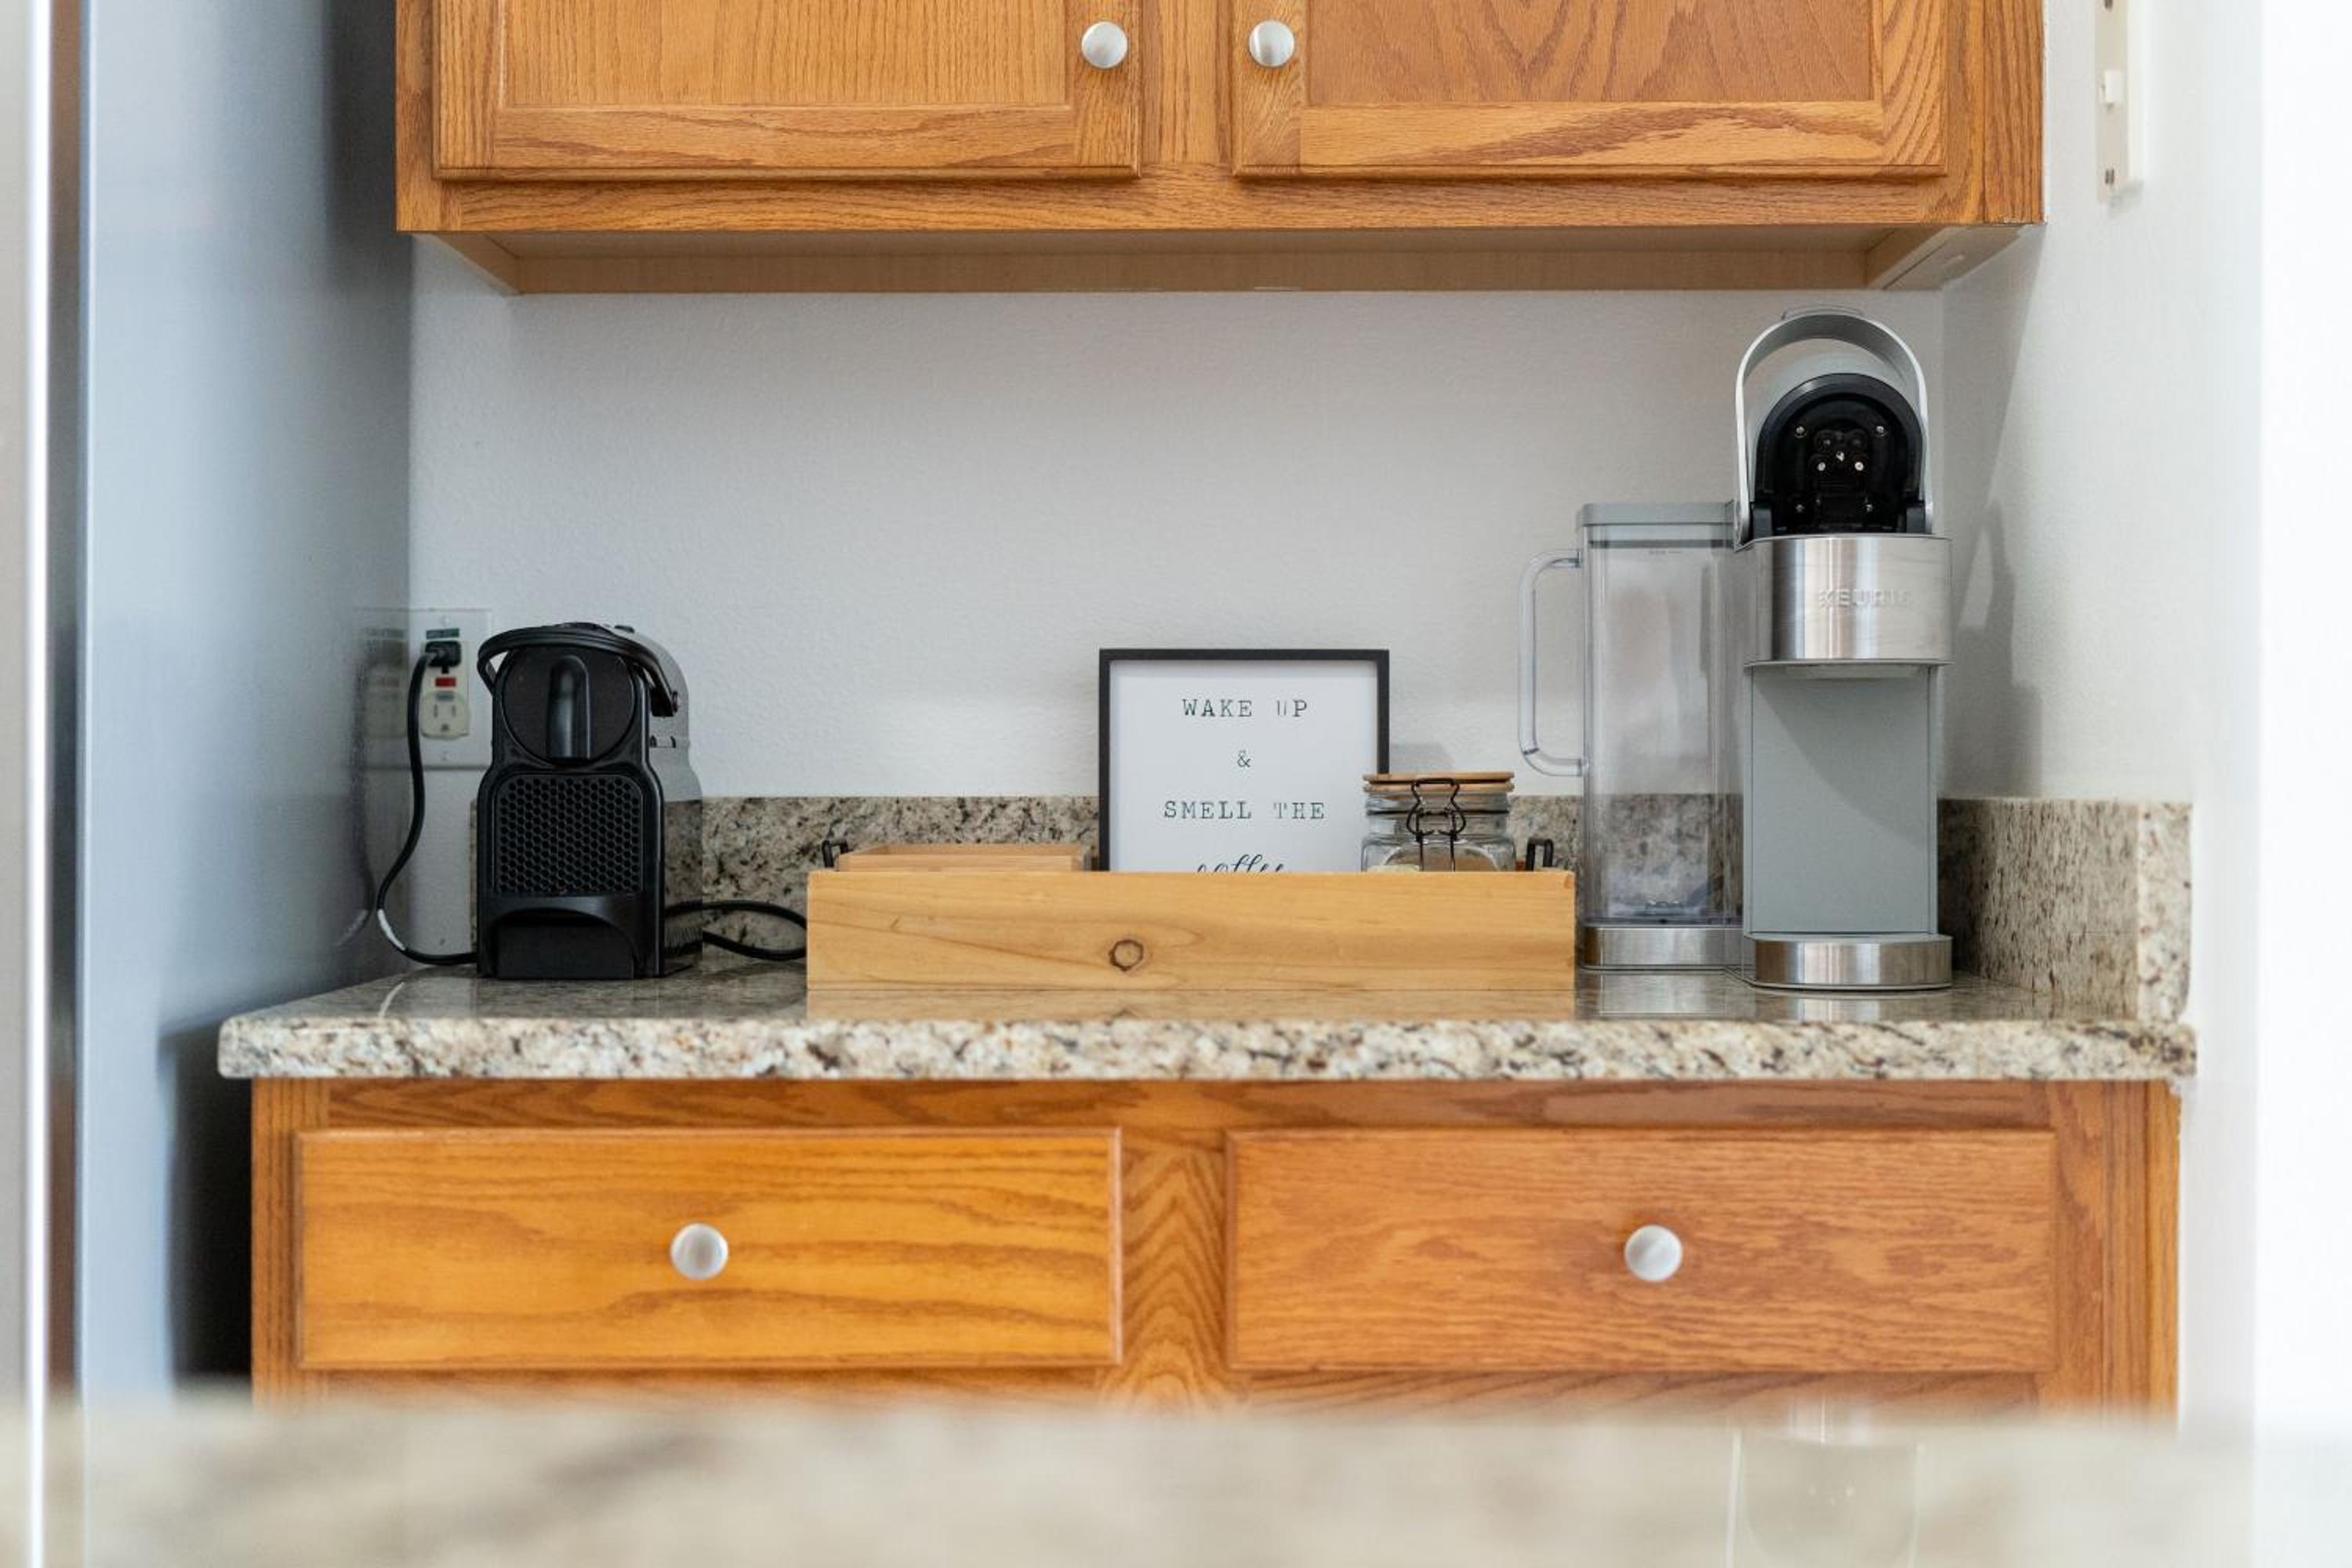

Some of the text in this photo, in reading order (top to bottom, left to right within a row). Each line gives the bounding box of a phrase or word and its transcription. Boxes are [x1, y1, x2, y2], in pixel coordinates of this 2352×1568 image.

[1181, 698, 1308, 718] WAKE UP
[1236, 750, 1252, 768] &
[1163, 800, 1325, 820] SMELL THE
